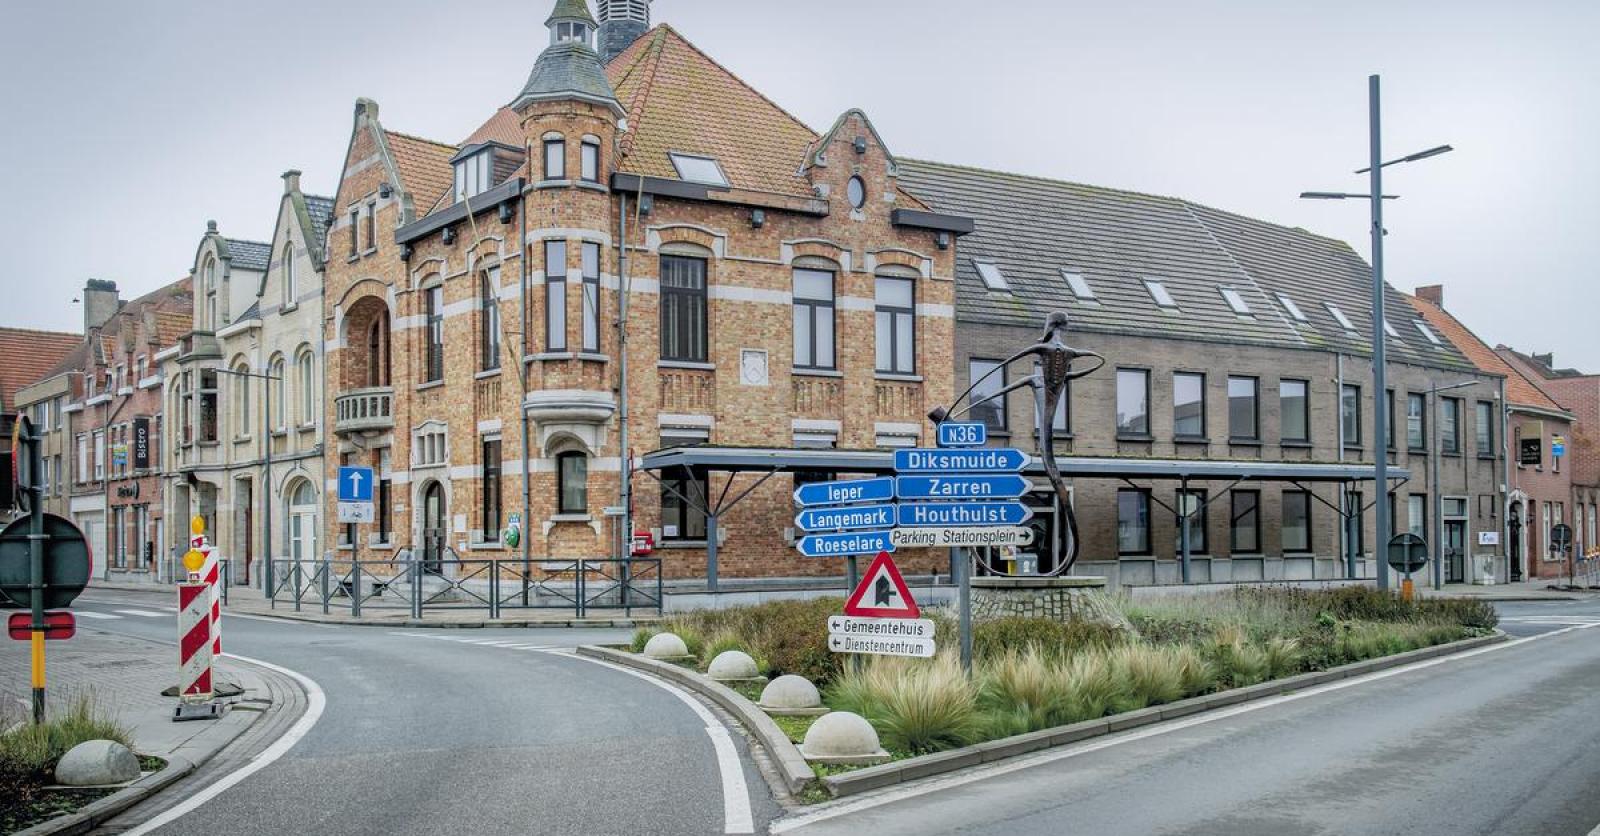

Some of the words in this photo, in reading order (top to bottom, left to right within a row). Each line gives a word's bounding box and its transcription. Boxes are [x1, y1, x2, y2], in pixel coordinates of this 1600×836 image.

[949, 426, 977, 442] N36
[908, 452, 1008, 468] Diksmuide
[828, 485, 863, 503] Ieper
[929, 479, 991, 494] Zarren
[810, 509, 887, 529] Langemark
[915, 506, 1007, 522] Houthulst
[815, 536, 883, 553] Roeselare
[893, 530, 936, 546] Parking
[943, 530, 1016, 545] Stationsplein
[844, 619, 924, 636] Gemeentehuis
[845, 636, 924, 655] Dienstencentrum
